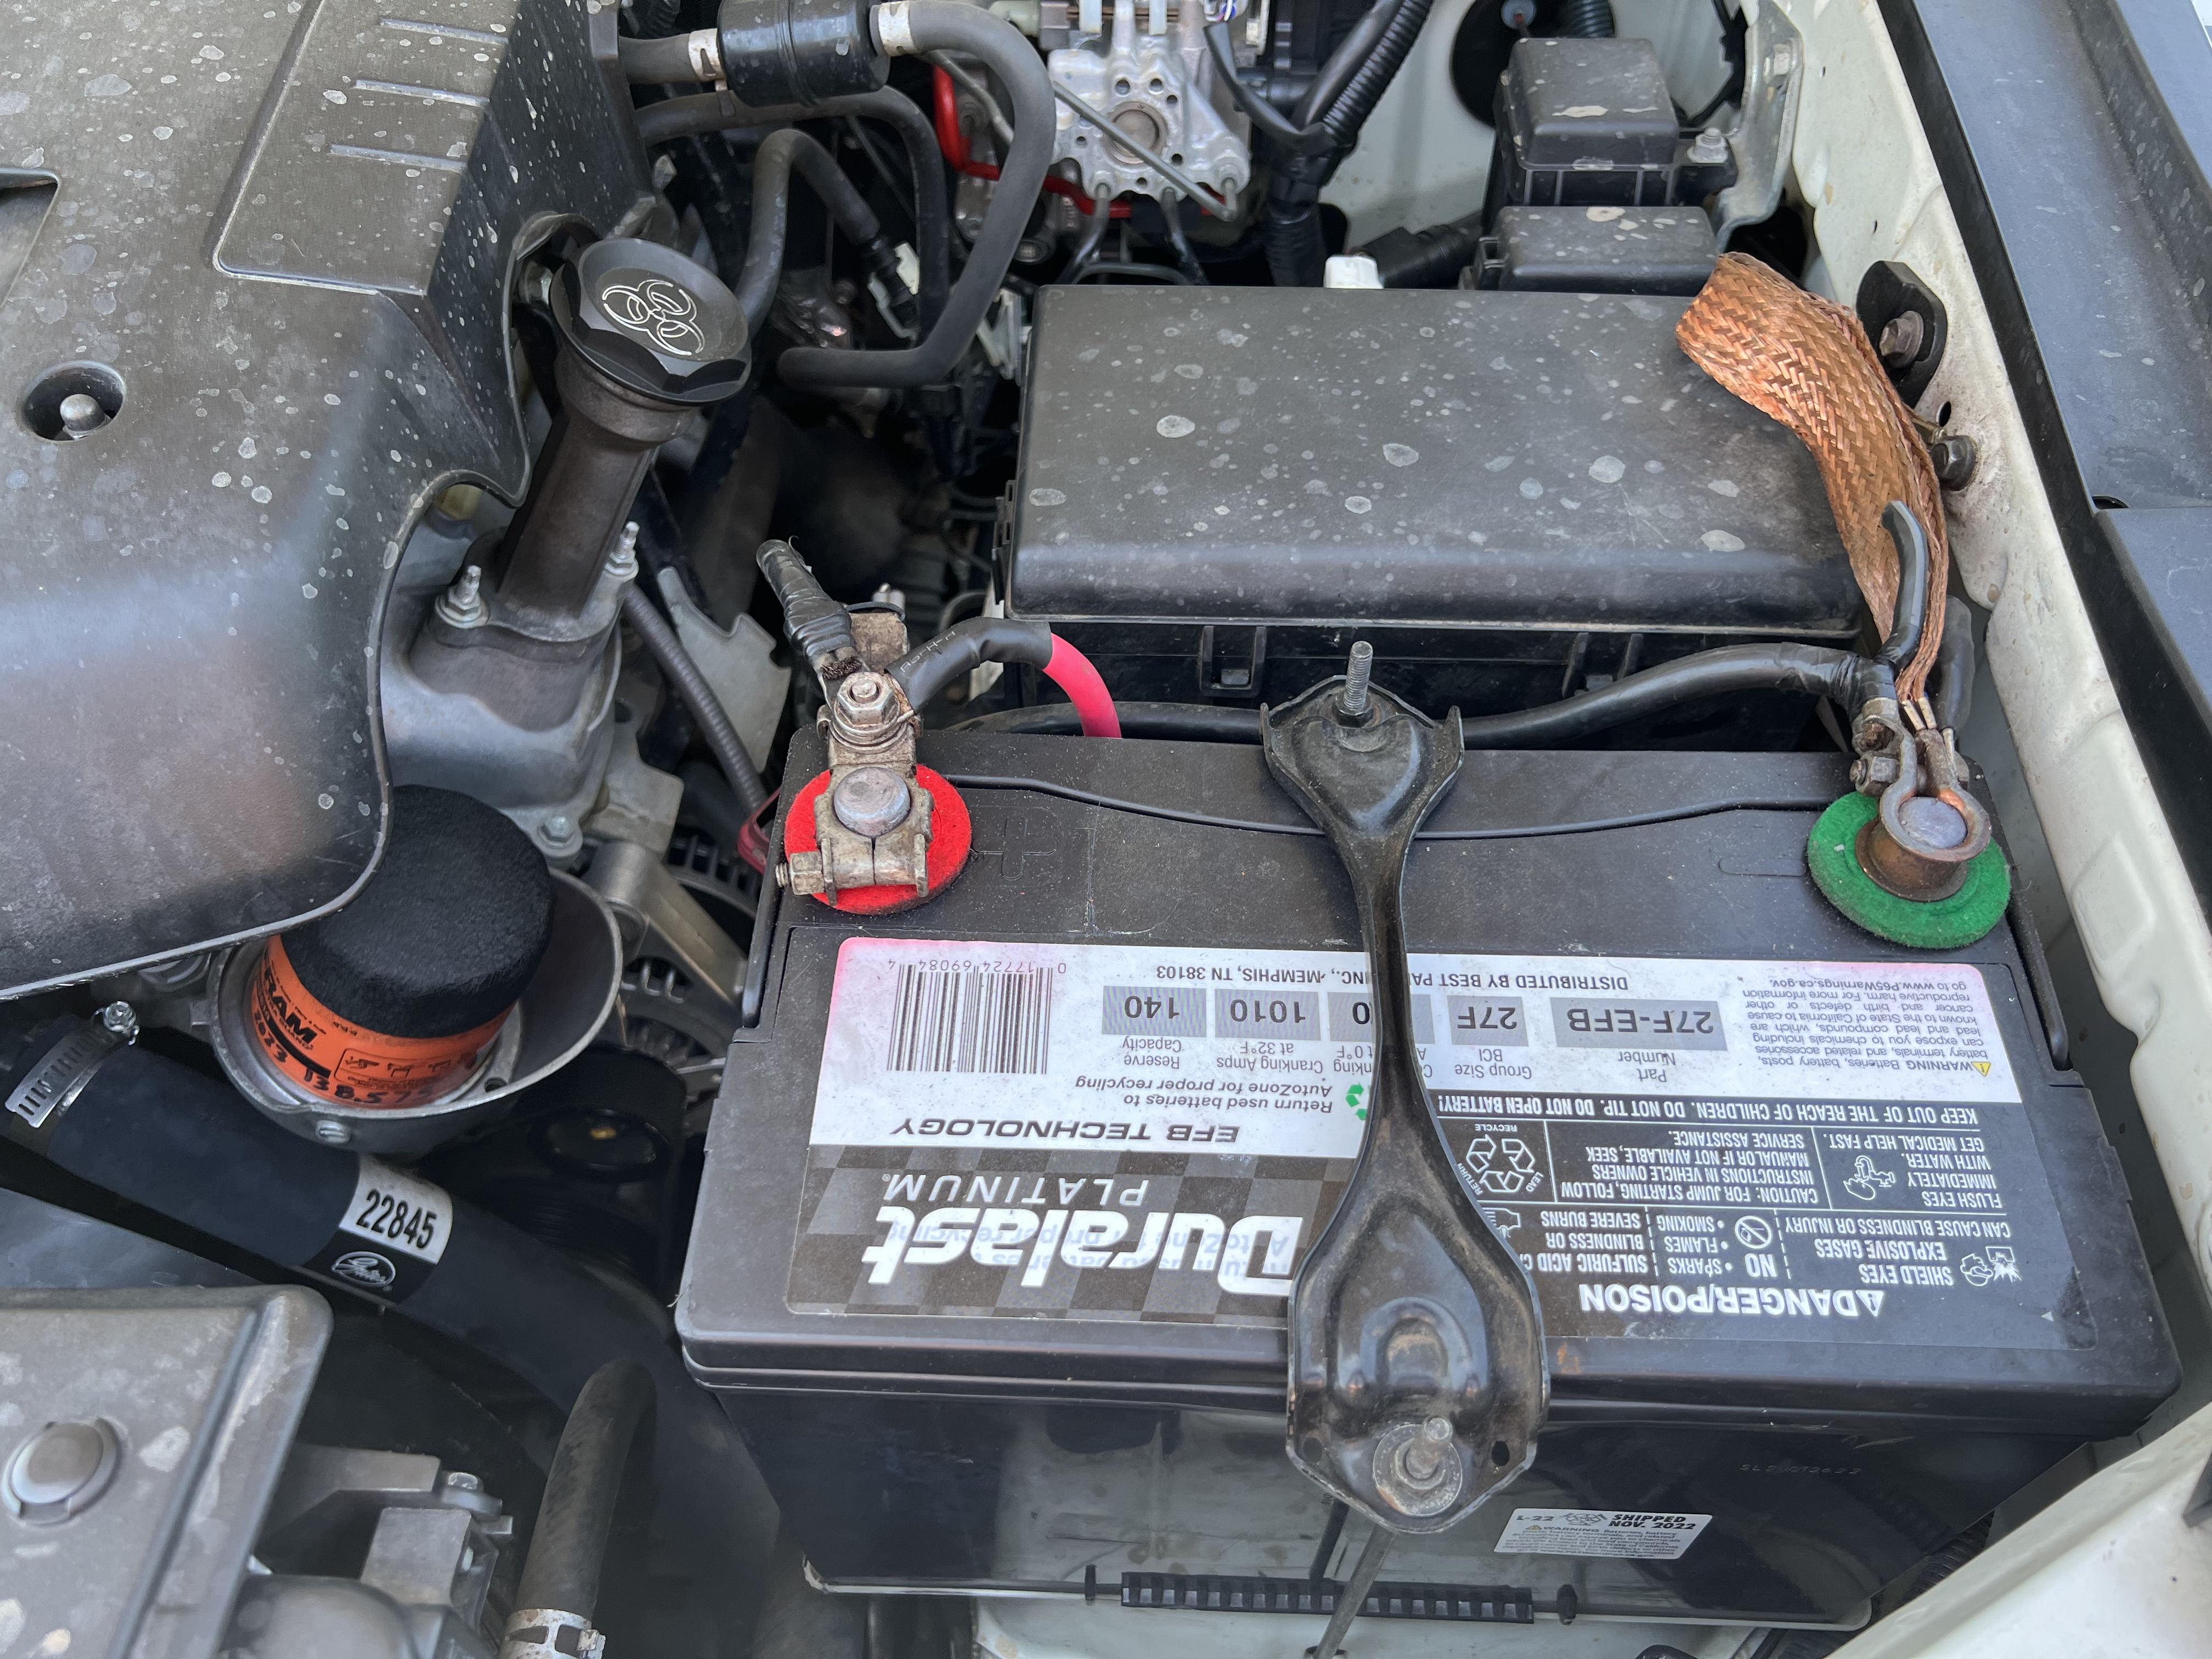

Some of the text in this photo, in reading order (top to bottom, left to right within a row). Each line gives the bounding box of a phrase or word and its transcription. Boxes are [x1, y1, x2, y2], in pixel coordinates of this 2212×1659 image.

[917, 959, 1033, 973] 17724 69084
[1156, 966, 1205, 980] 38103
[1212, 968, 1233, 981] TN
[1238, 966, 1321, 983] MEMPHIS,
[1438, 973, 1481, 988] BEST
[1488, 974, 1510, 988] BY
[1515, 975, 1628, 990] DISTRIBUTED
[1770, 978, 1967, 991] go to www.P65Warnings.ca.gov.
[1742, 989, 1806, 1001] information
[1842, 991, 1860, 1001] For
[1864, 991, 1897, 1001] harm.
[1898, 991, 1970, 1002] reproductive
[1124, 995, 1180, 1019] 140
[1230, 999, 1306, 1023] 1010
[1745, 1001, 1775, 1011] other
[1809, 1002, 1852, 1012] defects
[1863, 1003, 1890, 1013] birth
[1900, 1003, 1923, 1012] and
[1935, 1004, 1973, 1013] cancer
[1457, 1006, 1517, 1030] 27F
[1567, 1008, 1713, 1034] 27F-EFB
[1747, 1011, 1978, 1026] known to the State of California to cause
[1750, 1023, 1981, 1037] lead and lead compounds, which are
[1752, 1032, 1805, 1045] including
[1122, 1035, 1182, 1053] Capacity
[1809, 1035, 1867, 1046] chemicals
[1871, 1036, 1884, 1046] to
[1888, 1034, 1911, 1045] you
[1915, 1035, 1958, 1045] expose
[1240, 1041, 1294, 1056] at 32°F
[1479, 1048, 1503, 1062] BCI
[1754, 1046, 1989, 1060] battery terminals, and related accessories
[1124, 1054, 1180, 1069] Reserve
[1216, 1055, 1323, 1074] Cranking Amps
[1617, 1051, 1676, 1066] Number
[1758, 1056, 1972, 1071] WARNING Batteries, battery posts,
[1454, 1063, 1532, 1080] Group Size
[1636, 1068, 1667, 1083] Part
[1075, 1075, 1333, 1097] AutoZone for proper recycling
[1124, 1094, 1333, 1114] Return used batteries to
[1438, 1095, 1978, 1125] KEEP OUT OF THE REACH OF CHILDREN. DO NOT TIP. DO NOT OPEN BATTERY!
[891, 1118, 1240, 1143] EFB TECHNOLOGY
[1474, 1124, 1517, 1132] RECYCLE
[1668, 1131, 1805, 1149] SERVICE ASSISTANCE.
[1823, 1133, 1985, 1152] GET MEDICAL HELP FAST.
[1585, 1145, 1809, 1167] MANUAL OR IF NOT AVAILABLE, SEEK
[1901, 1153, 1991, 1170] WITH WATER.
[1457, 1162, 1483, 1195] RETURN
[1525, 1171, 1545, 1194] LEAD
[1592, 1164, 1814, 1185] INSTRUCTIONS IN VEHICLE OWNERS
[1907, 1172, 1997, 1189] IMMEDIATELY
[1561, 1181, 1818, 1204] CAUTION: FOR JUMP STARTING, FOLLOW
[1921, 1191, 2002, 1209] FLUSH EYES
[356, 1188, 438, 1250] 22845
[1540, 1210, 1641, 1229] SEVERE BURNS
[1656, 1215, 1715, 1232] SMOKING
[1785, 1217, 2011, 1238] CAN CAUSE BLINDNESS OR INJURY
[1545, 1232, 1644, 1250] BLINDNESS OR
[1664, 1236, 1718, 1253] FLAMES
[1814, 1238, 1948, 1261] EXPLOSIVE GASES
[861, 1206, 1305, 1296] Duralast
[1537, 1252, 1572, 1272] ACID
[1576, 1253, 1649, 1273] SULFURIC
[1667, 1257, 1723, 1274] SPARKS
[1745, 1253, 1778, 1278] NO
[1858, 1263, 1954, 1286] SHIELD EYES
[1579, 1284, 1857, 1316] DANGER/POISON
[1611, 1513, 1686, 1523] SHIPPED
[1652, 1522, 1697, 1530] 2022
